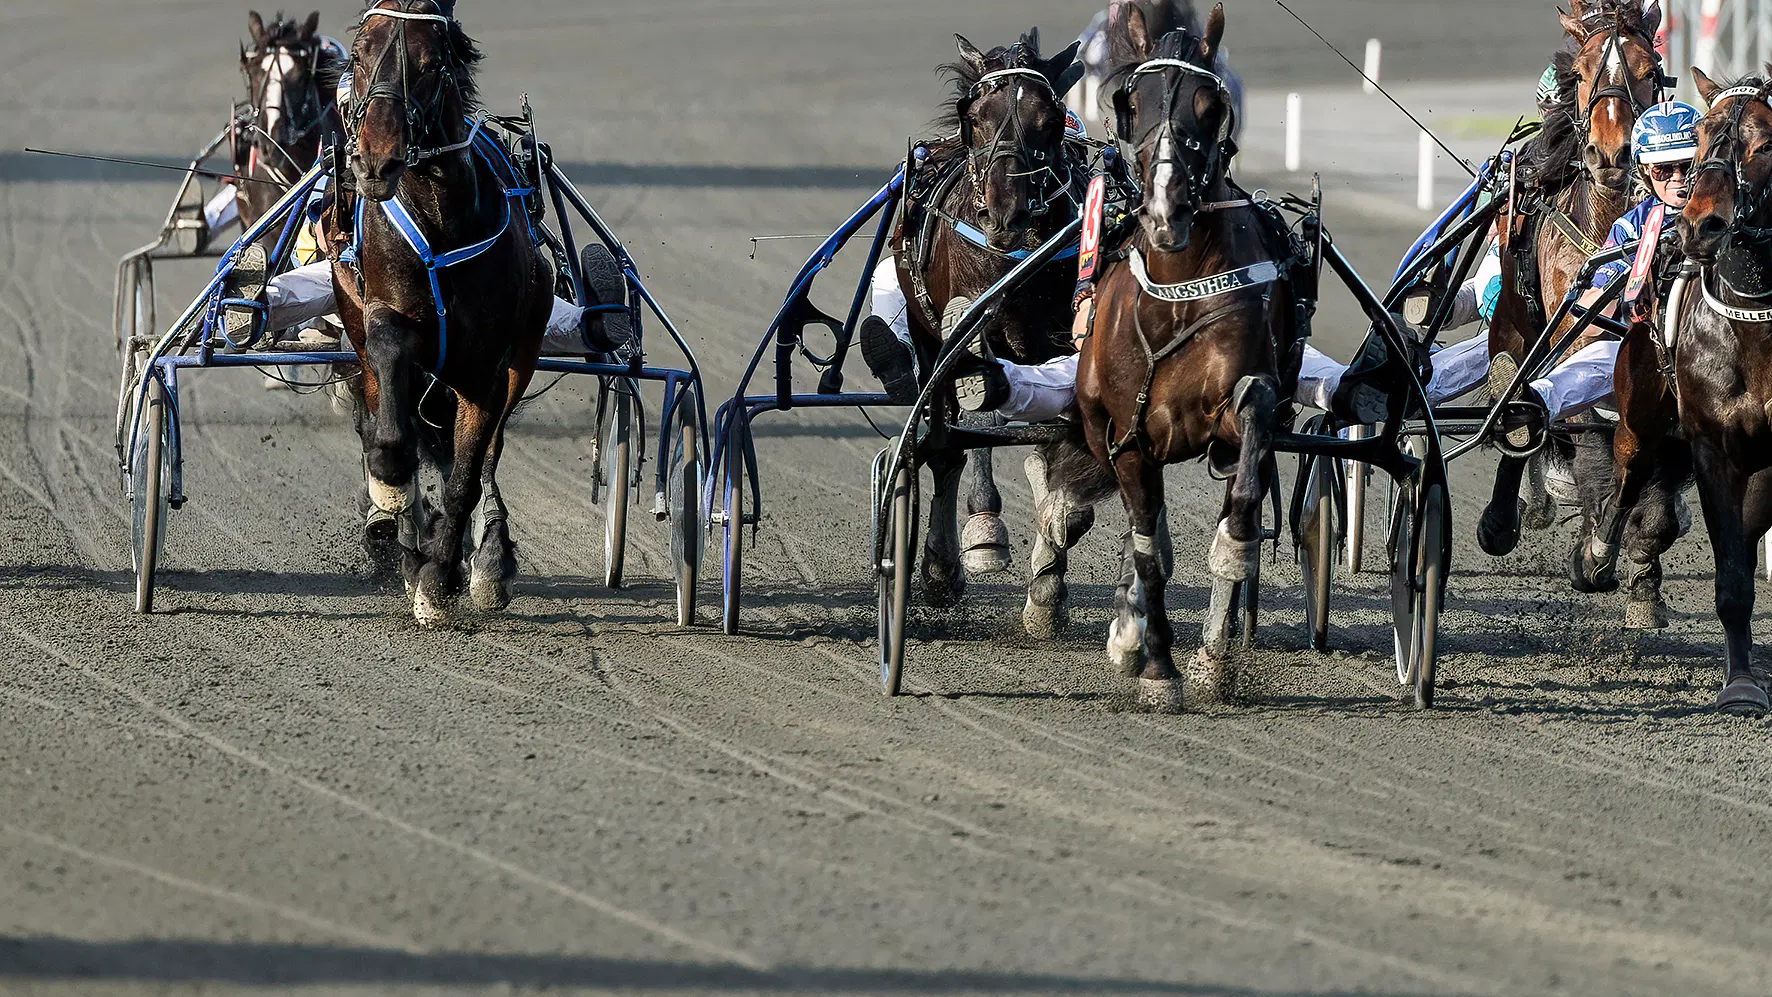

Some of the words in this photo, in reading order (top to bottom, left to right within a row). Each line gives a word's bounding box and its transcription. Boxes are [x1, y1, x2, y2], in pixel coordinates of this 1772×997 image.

[1082, 178, 1103, 253] 13
[1636, 208, 1661, 276] 6
[1158, 273, 1243, 299] ANGSTHEA
